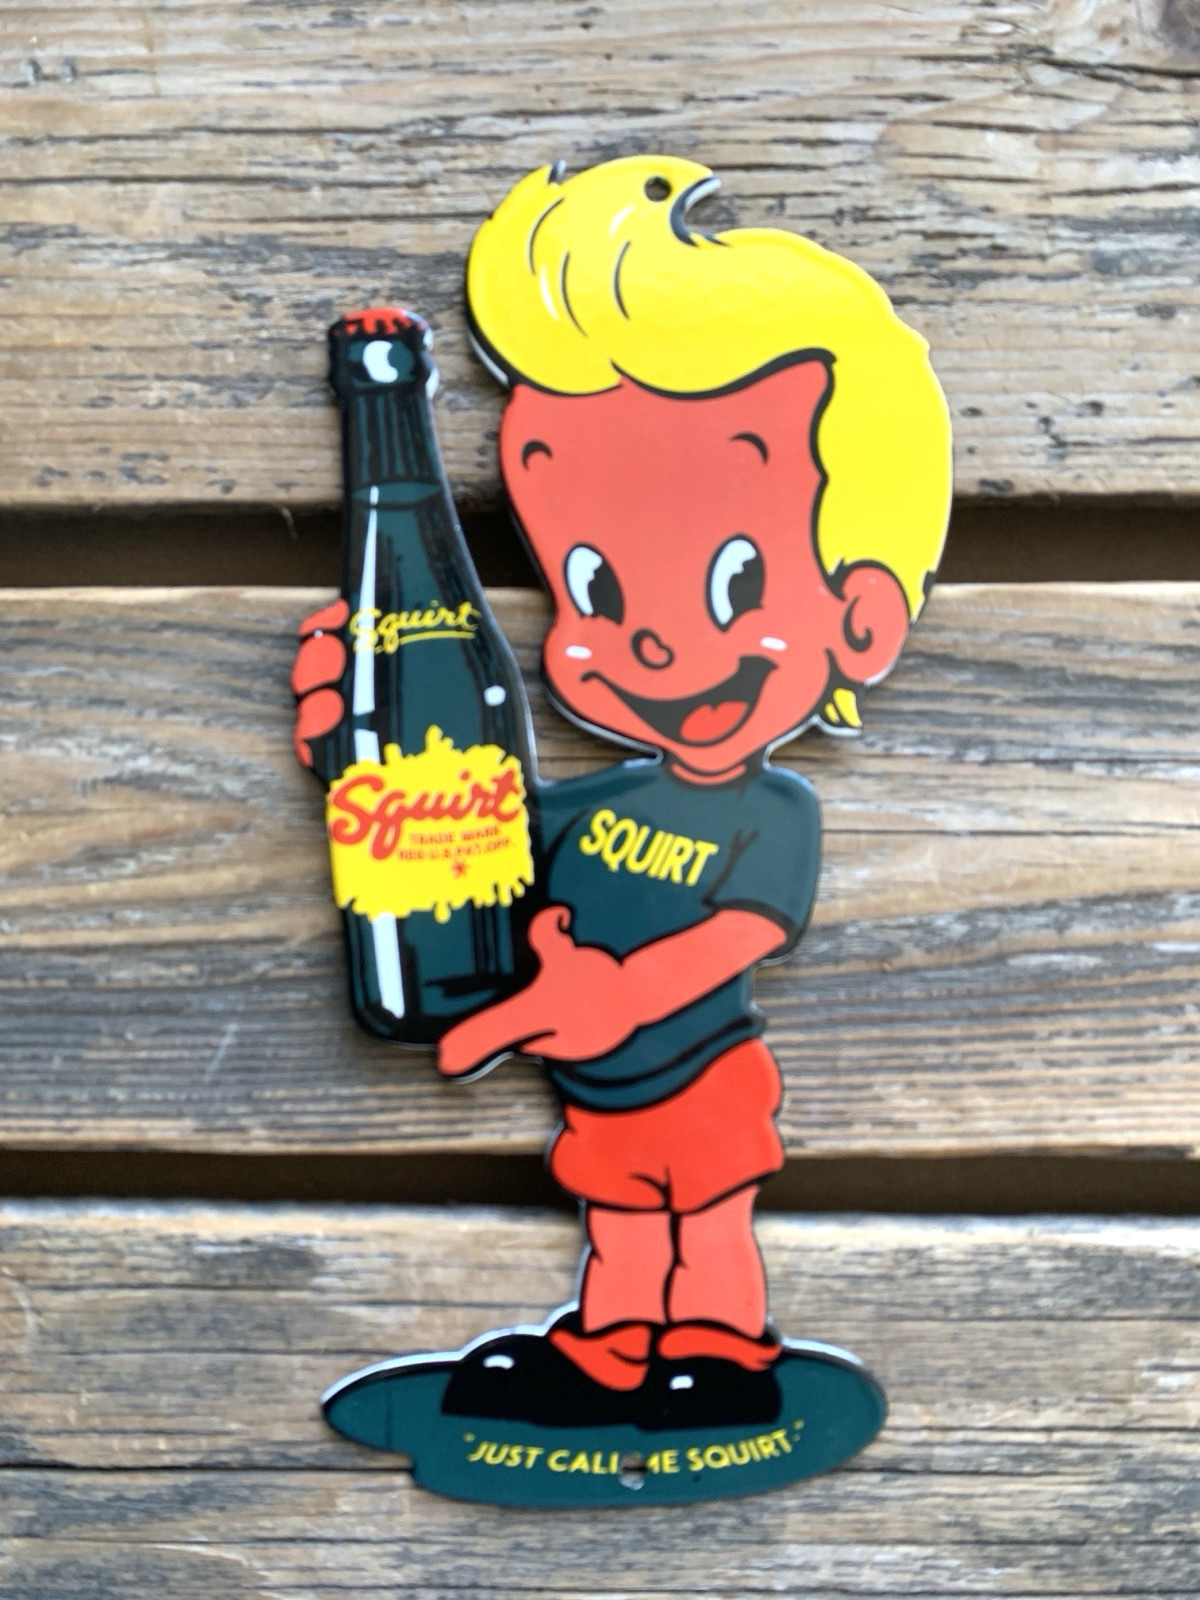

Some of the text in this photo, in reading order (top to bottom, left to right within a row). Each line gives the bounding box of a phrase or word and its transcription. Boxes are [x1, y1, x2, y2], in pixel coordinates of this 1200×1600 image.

[350, 600, 481, 654] Squirt
[331, 769, 519, 860] Squirt
[579, 808, 719, 886] SQUIRT
